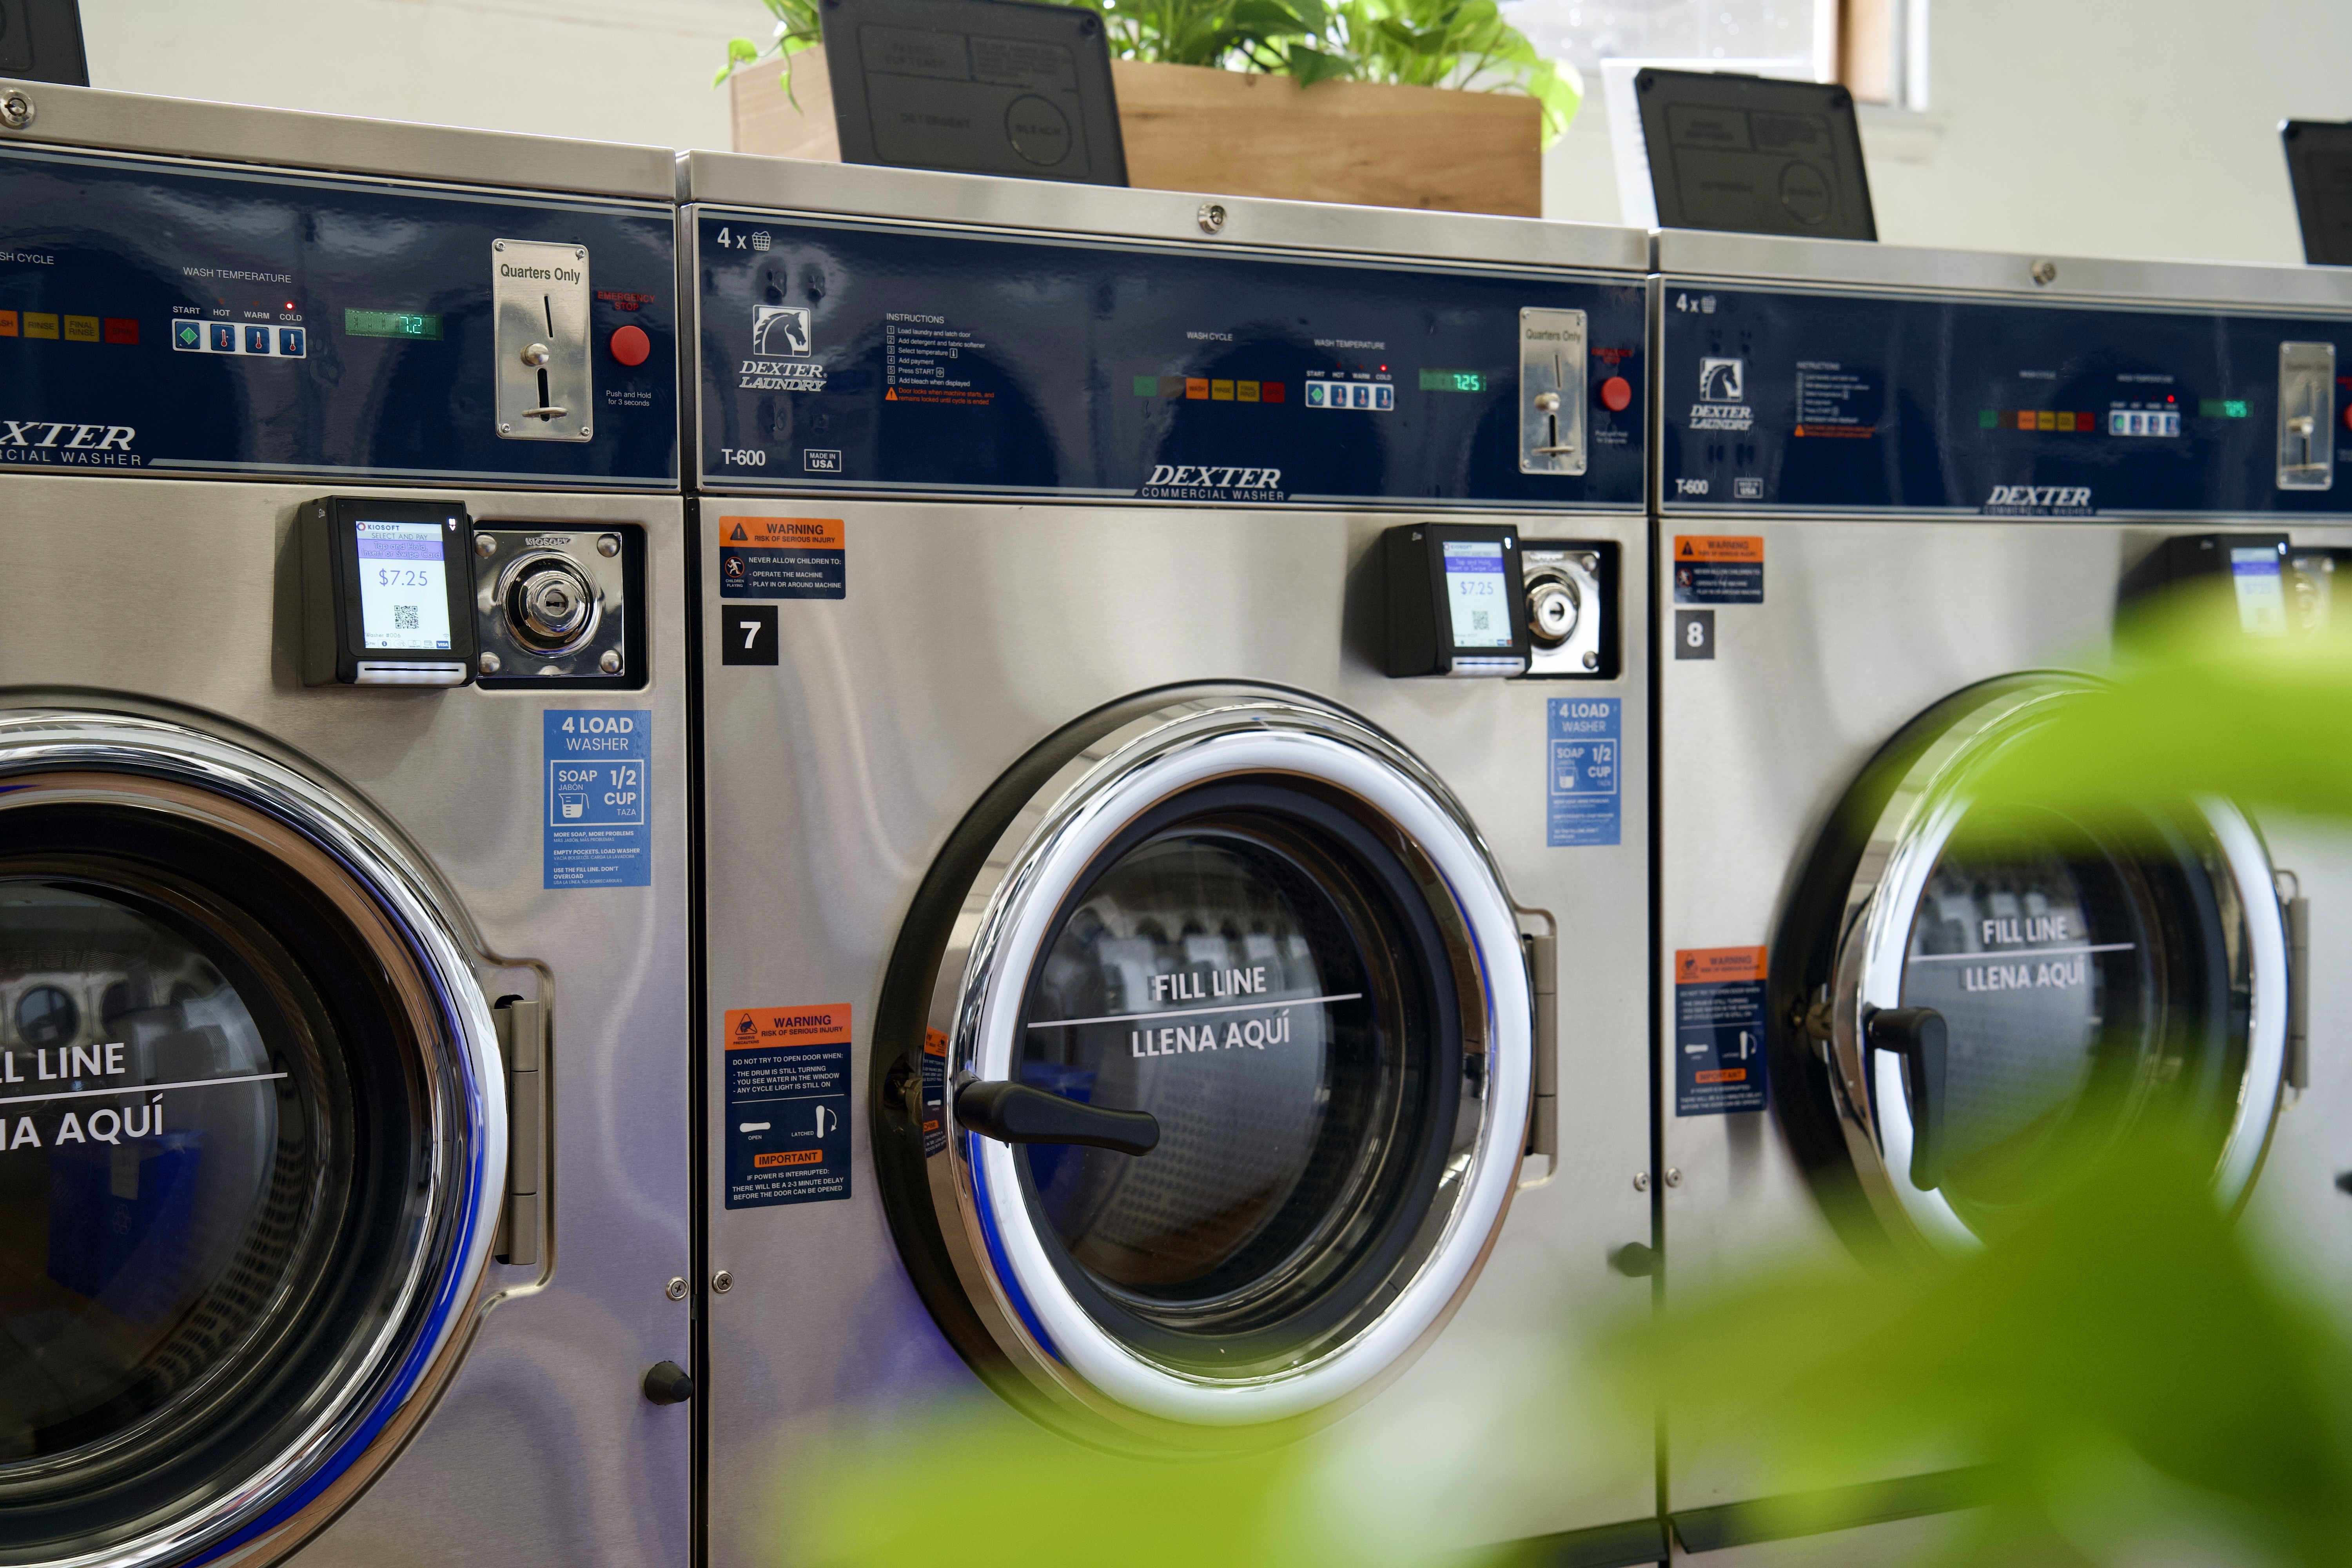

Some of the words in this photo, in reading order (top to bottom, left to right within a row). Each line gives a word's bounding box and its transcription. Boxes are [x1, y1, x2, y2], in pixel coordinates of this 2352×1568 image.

[717, 227, 731, 248] 4
[17, 254, 54, 265] CYCLE
[183, 267, 213, 277] WASH
[216, 270, 292, 283] TEMPERATURE
[501, 264, 551, 279] Quarters
[554, 268, 581, 285] Only
[597, 291, 655, 303] EMERGENCY
[615, 302, 639, 311] STOP
[886, 313, 944, 324] INSTRUCTIONS
[69, 328, 95, 336] RINSE
[1209, 332, 1233, 341] CYCLE
[1526, 328, 1561, 341] Quarters
[1563, 330, 1581, 343] Only
[739, 376, 827, 392] LAUNDRY
[1690, 405, 1750, 418] DEXTER
[0, 421, 135, 450] XTER
[61, 452, 141, 466] WASHER
[721, 448, 765, 466] T-600
[812, 460, 833, 468] USA
[1145, 465, 1281, 488] DEXTER
[1142, 487, 1227, 499] COMMERCIAL
[1232, 490, 1284, 501] WASHER
[1986, 486, 2091, 506] DEXTER
[767, 523, 823, 535] WARNING
[374, 542, 388, 551] Tap
[396, 550, 419, 559] Swipe
[379, 568, 428, 587] $7.25
[1460, 581, 1494, 595] $7.25
[740, 621, 761, 649] 7
[1687, 621, 1704, 647] 8
[1559, 704, 1568, 718] 4
[1571, 703, 1609, 718] LOAD
[562, 717, 575, 733] 4
[580, 717, 633, 733] LOAD
[1562, 720, 1606, 732] WASHER
[566, 738, 628, 750] WASHER
[1557, 748, 1585, 759] SOAP
[1592, 744, 1612, 764] 1/2
[559, 770, 598, 782] SOAP
[610, 766, 636, 789] 1/2
[1588, 766, 1612, 778] CUP
[558, 782, 583, 791] JABÓN
[604, 792, 636, 805] CUP
[1982, 918, 2023, 944] FILL
[2025, 916, 2067, 942] LINE
[1155, 972, 1205, 1001] FILL
[1213, 967, 1266, 996] LINE
[1966, 964, 2032, 992] LLENA
[774, 1015, 831, 1028] WARNING
[1132, 1025, 1217, 1057] LLENA
[1225, 1008, 1289, 1050] AQUÍ
[38, 1042, 125, 1080] LINE
[56, 1093, 163, 1146] AQUÍ
[759, 1152, 817, 1165] IMPORTANT
[786, 1169, 829, 1177] INTERRUPTED:
